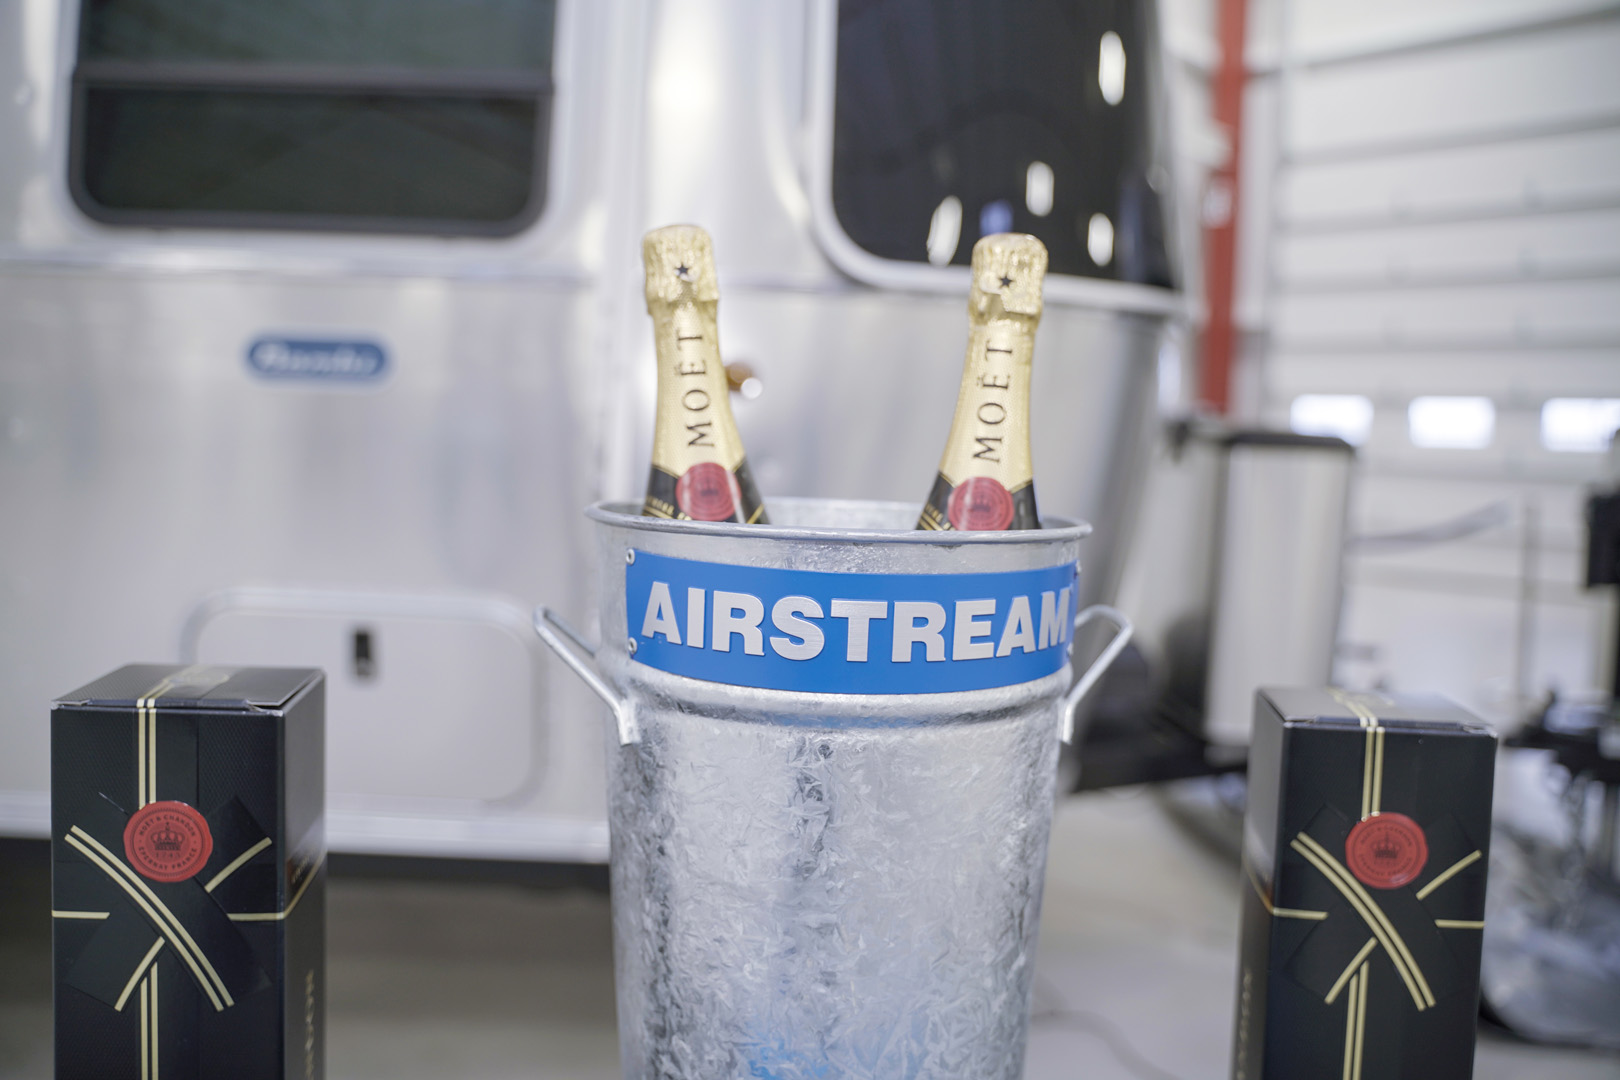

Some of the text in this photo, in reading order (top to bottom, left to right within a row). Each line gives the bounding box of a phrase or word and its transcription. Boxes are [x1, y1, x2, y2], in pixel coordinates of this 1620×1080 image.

[674, 327, 715, 447] MOËT
[973, 340, 1013, 463] MOËT
[641, 581, 1071, 663] AIRSTREAM
